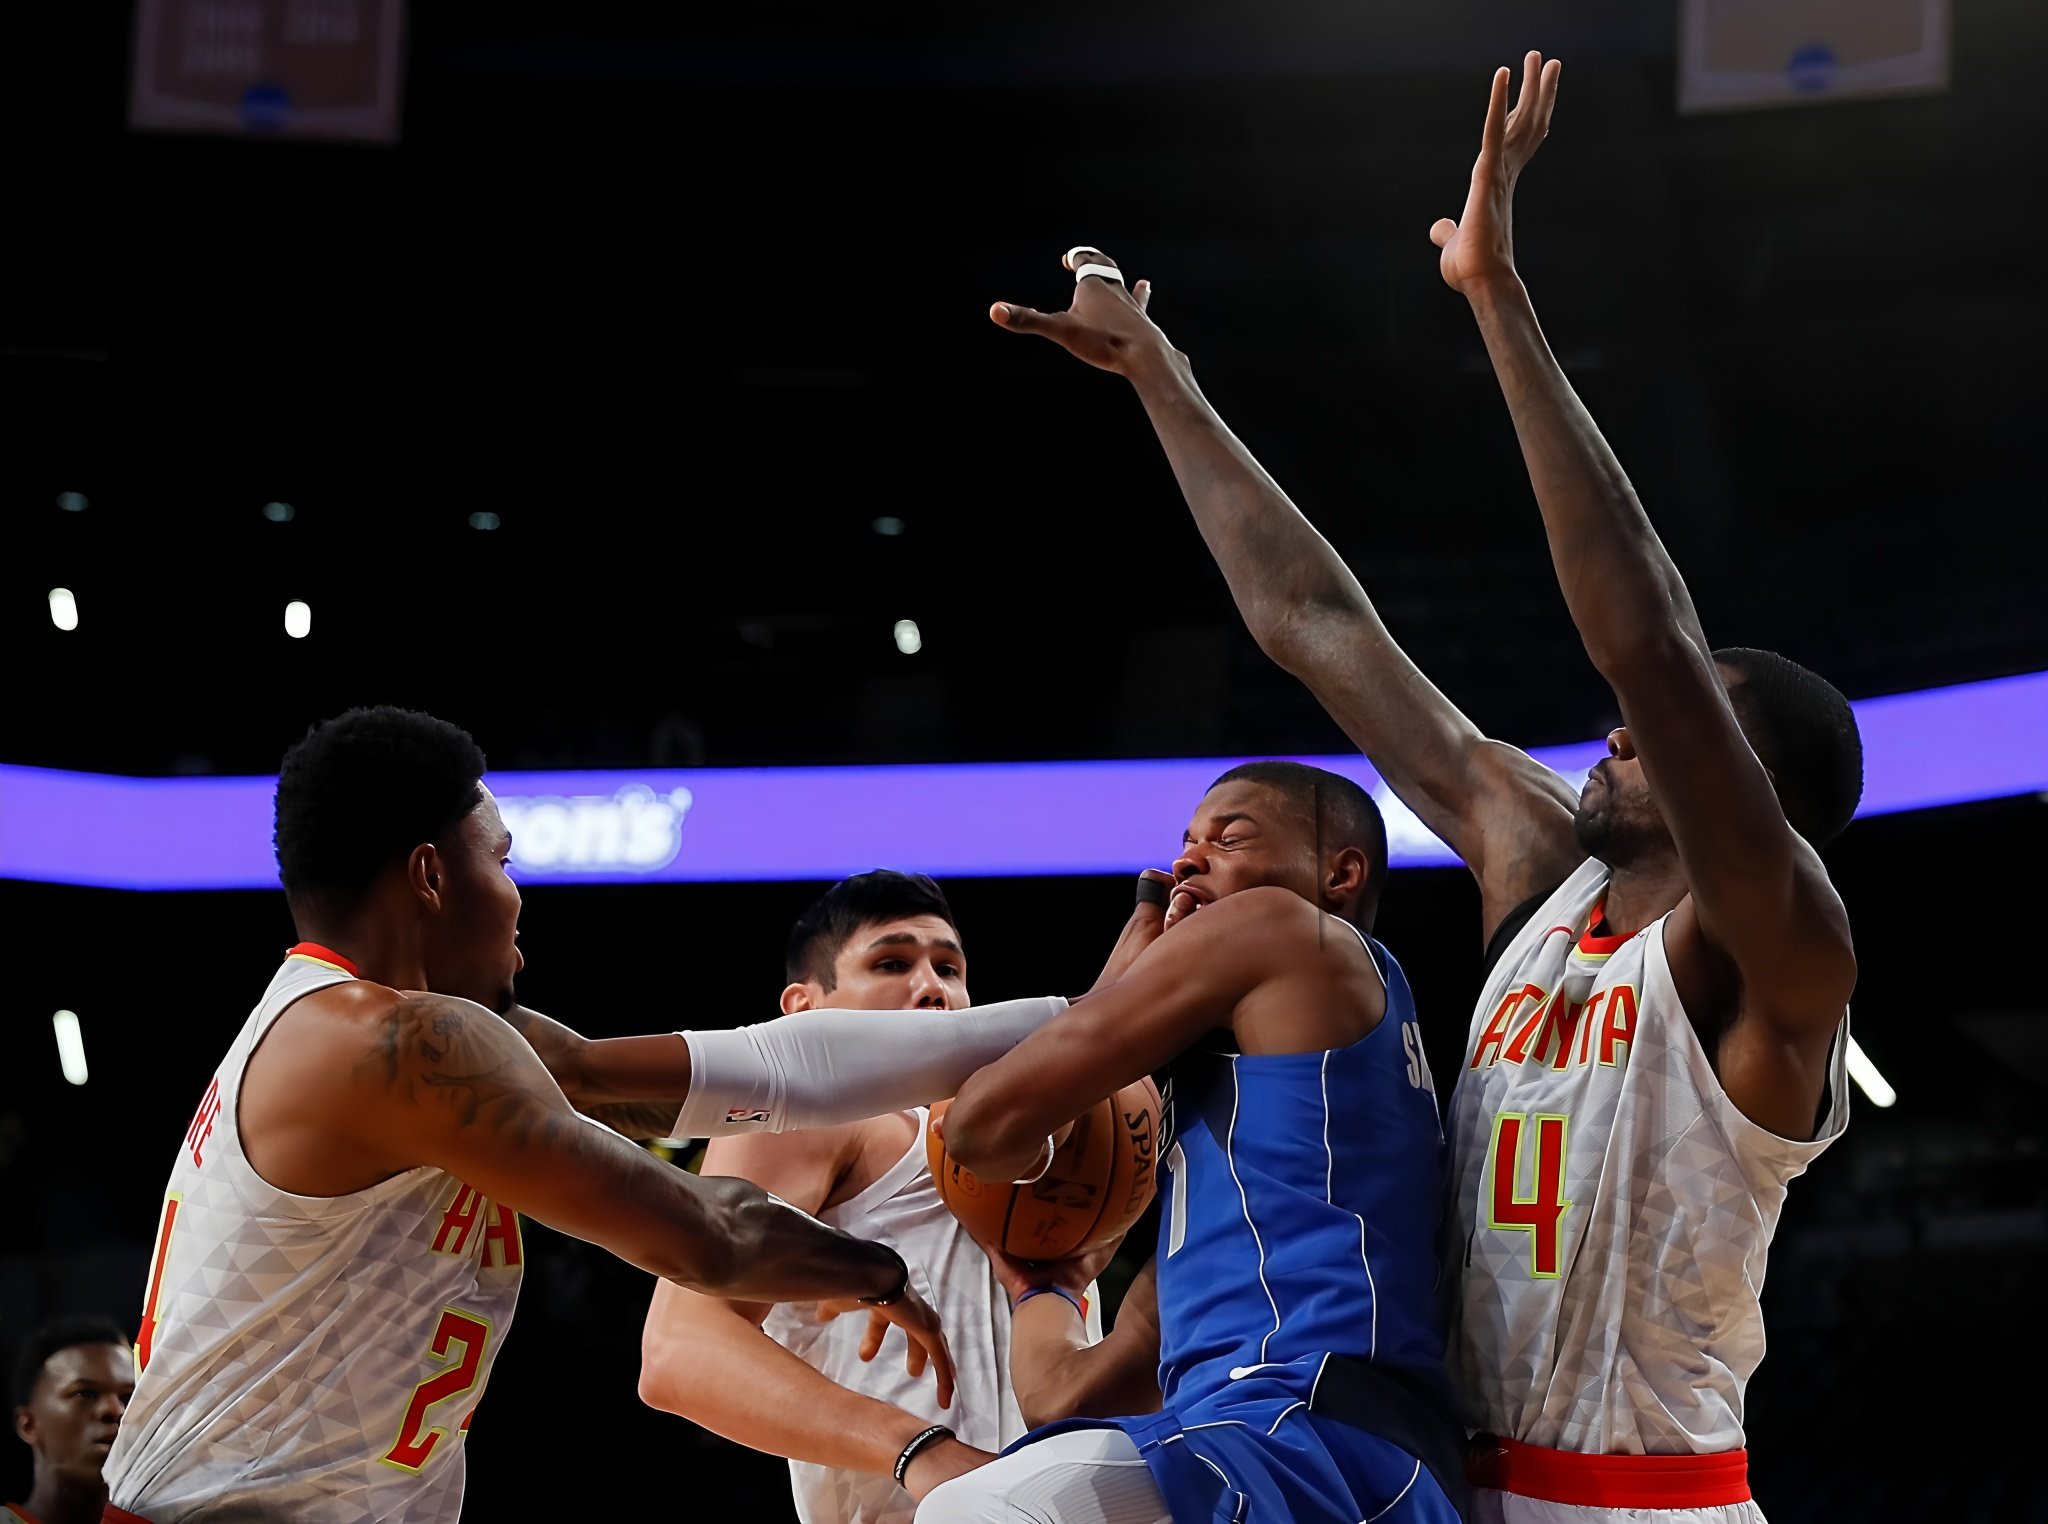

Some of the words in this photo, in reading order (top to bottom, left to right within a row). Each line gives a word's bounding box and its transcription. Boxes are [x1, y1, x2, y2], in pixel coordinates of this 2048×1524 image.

[498, 785, 683, 873] on's
[1488, 1112, 1573, 1279] 4
[377, 1304, 493, 1476] 2
